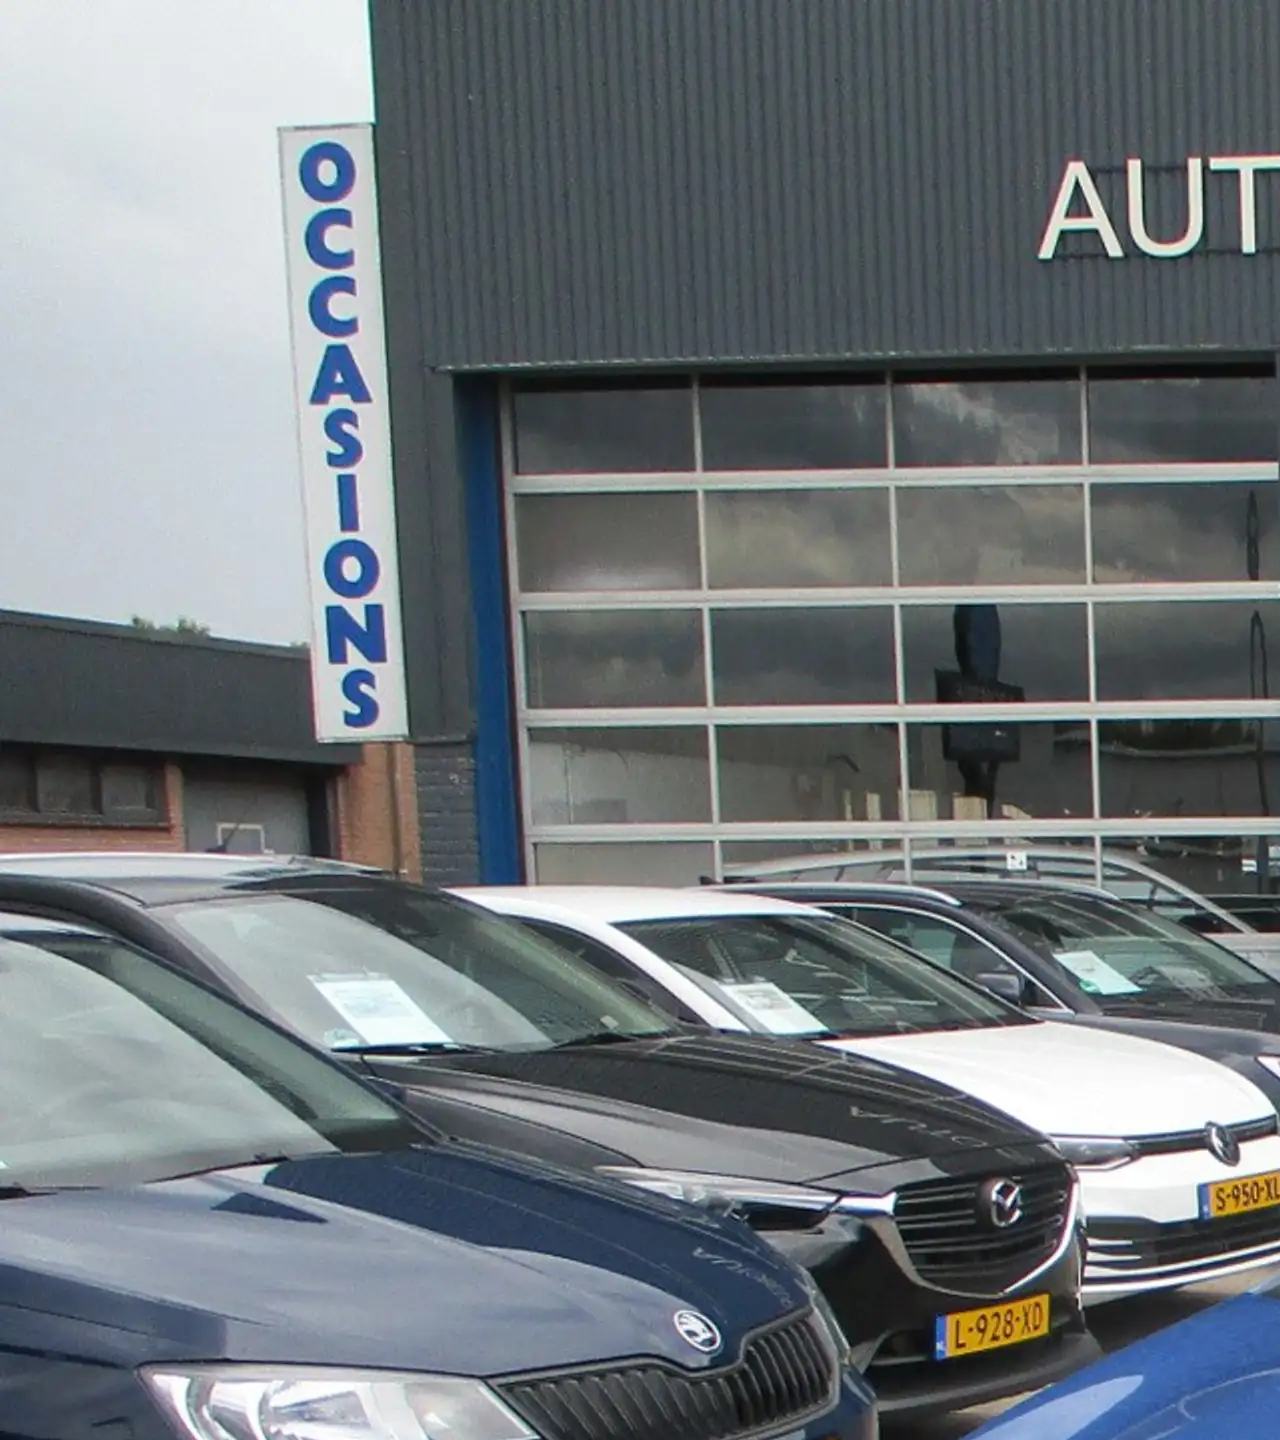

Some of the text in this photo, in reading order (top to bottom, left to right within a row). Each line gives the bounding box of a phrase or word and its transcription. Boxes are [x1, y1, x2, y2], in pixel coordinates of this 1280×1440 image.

[299, 141, 388, 728] OCCASIONS
[1216, 1177, 1280, 1212] S-950-XL
[955, 1301, 1044, 1349] L-928-XD
